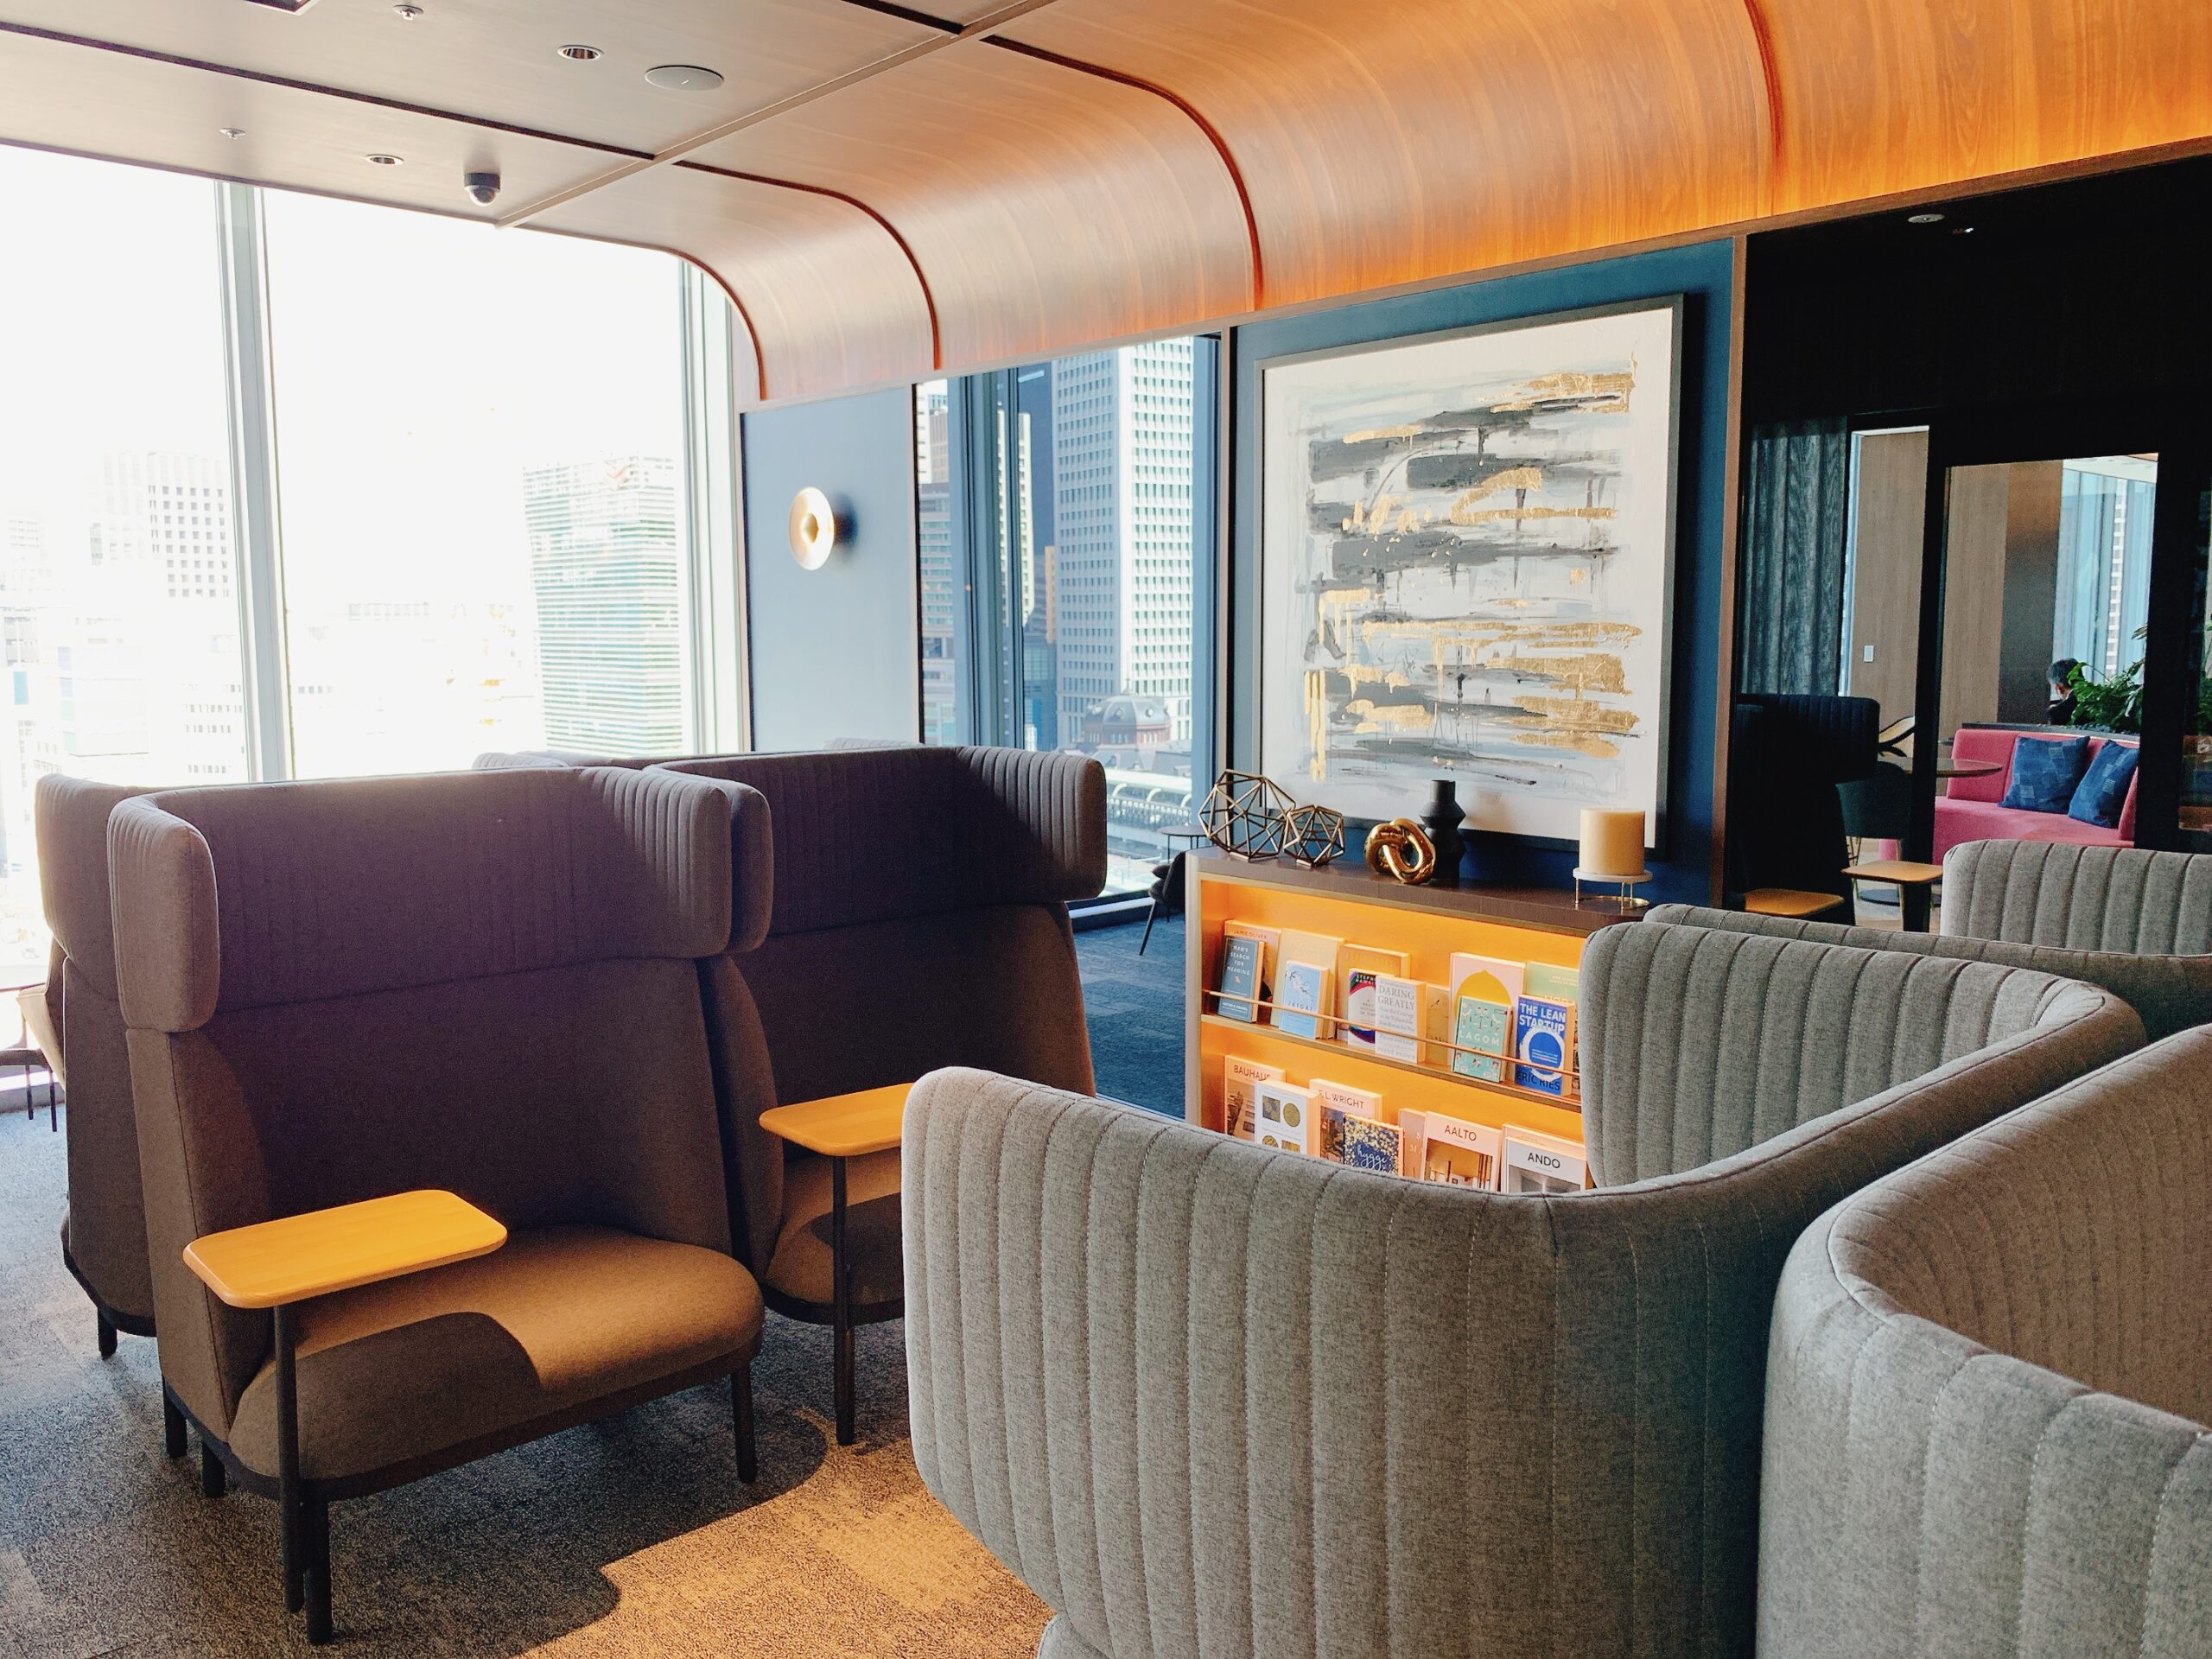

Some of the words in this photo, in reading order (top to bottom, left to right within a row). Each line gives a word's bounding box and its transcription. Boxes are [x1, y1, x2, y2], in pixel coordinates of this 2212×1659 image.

[1227, 966, 1250, 976] MEANING
[1379, 985, 1414, 1001] DARING
[1288, 1001, 1313, 1011] IKIGAI
[1377, 995, 1415, 1010] GREATLY
[1519, 1003, 1538, 1016] THE
[1540, 1007, 1566, 1022] LEAN
[1519, 1014, 1565, 1035] STARTUP
[1459, 1030, 1500, 1046] LAGOM
[1516, 1071, 1537, 1084] ERIC
[1539, 1079, 1560, 1091] RIES
[1445, 1125, 1477, 1141] AALTO
[1357, 1144, 1388, 1170] hygge
[1528, 1152, 1560, 1169] ANDO
